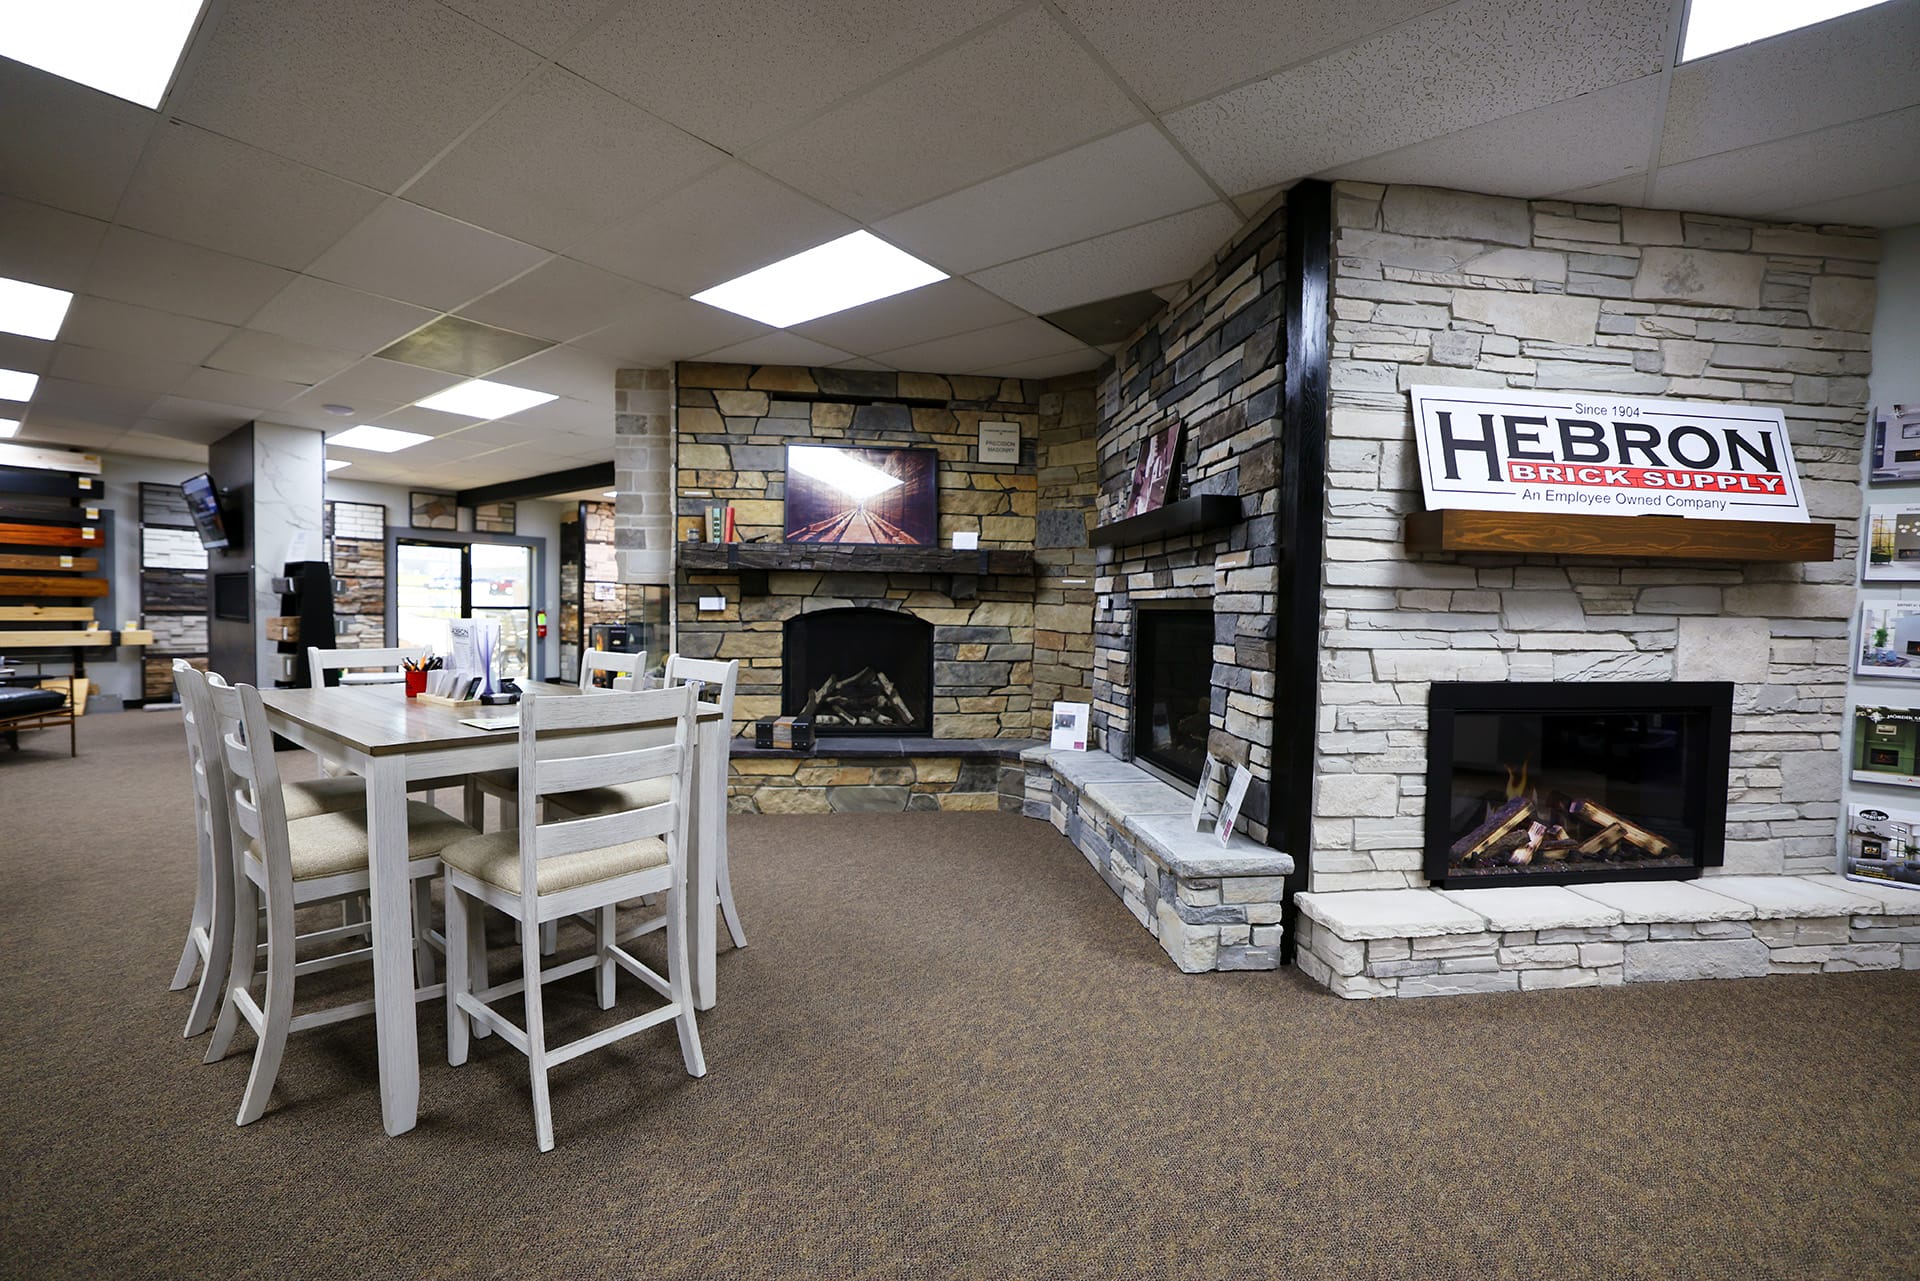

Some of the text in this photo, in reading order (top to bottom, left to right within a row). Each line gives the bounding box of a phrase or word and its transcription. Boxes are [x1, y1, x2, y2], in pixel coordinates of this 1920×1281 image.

[1575, 402, 1640, 418] Since 1904
[1435, 410, 1782, 482] HEBRON
[1511, 464, 1783, 493] BRICK SUPPLY
[1522, 489, 1727, 511] An Employee Owned Company
